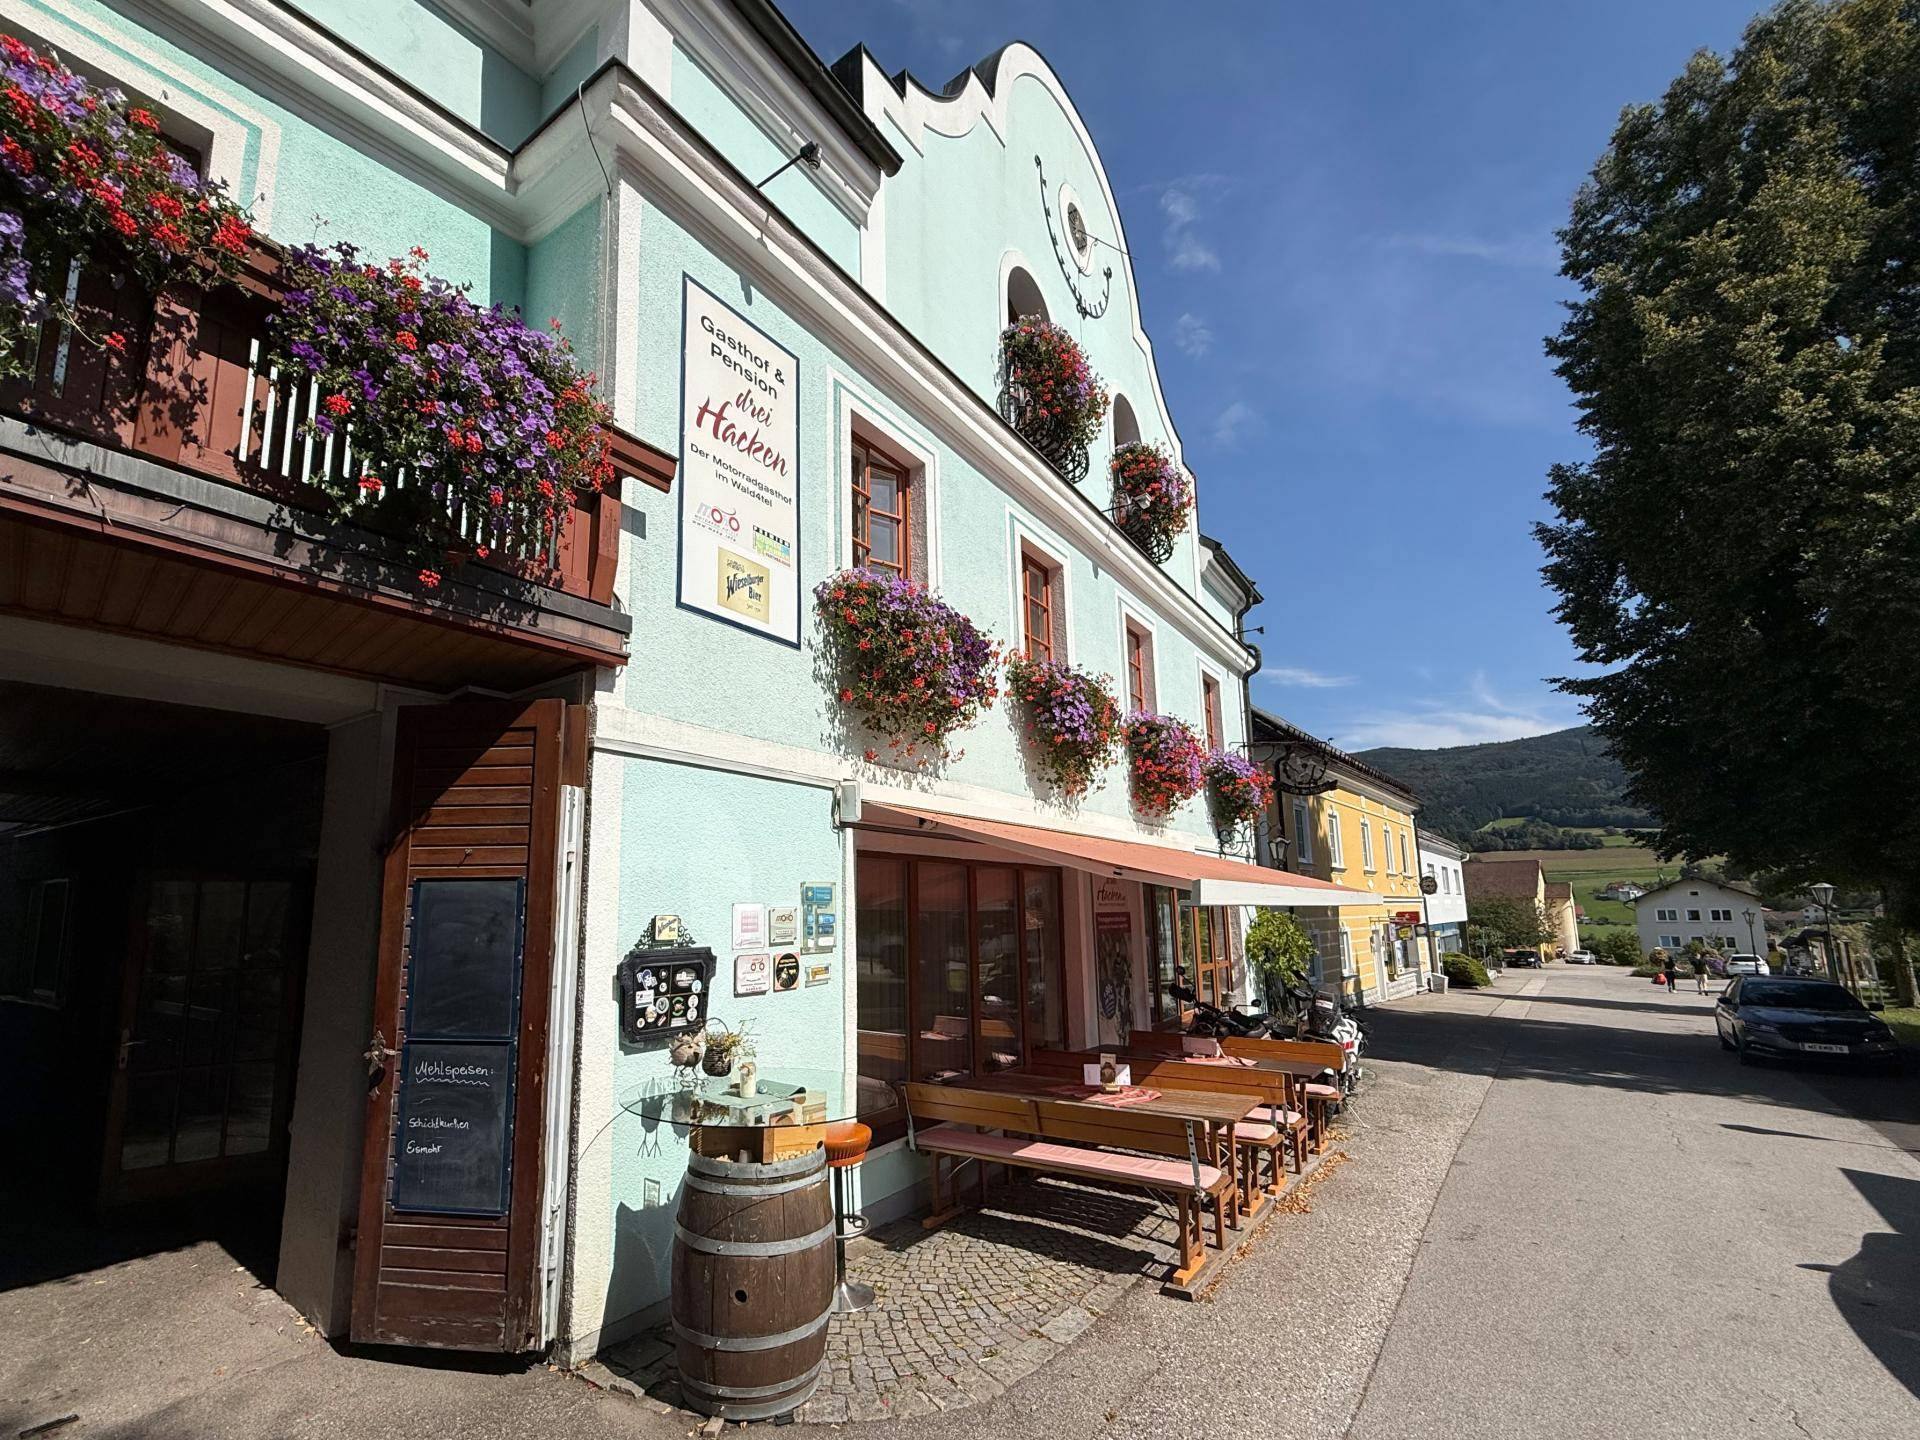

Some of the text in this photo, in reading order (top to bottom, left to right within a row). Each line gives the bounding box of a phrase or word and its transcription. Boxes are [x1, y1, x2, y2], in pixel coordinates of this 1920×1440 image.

[700, 315, 786, 386] Gasthof &
[711, 342, 778, 400] Pension
[695, 395, 788, 478] Hacken
[735, 388, 773, 428] drei
[690, 442, 792, 506] Der Motorradgasthof
[715, 469, 773, 508] im Wald4tel
[748, 586, 762, 602] Bier
